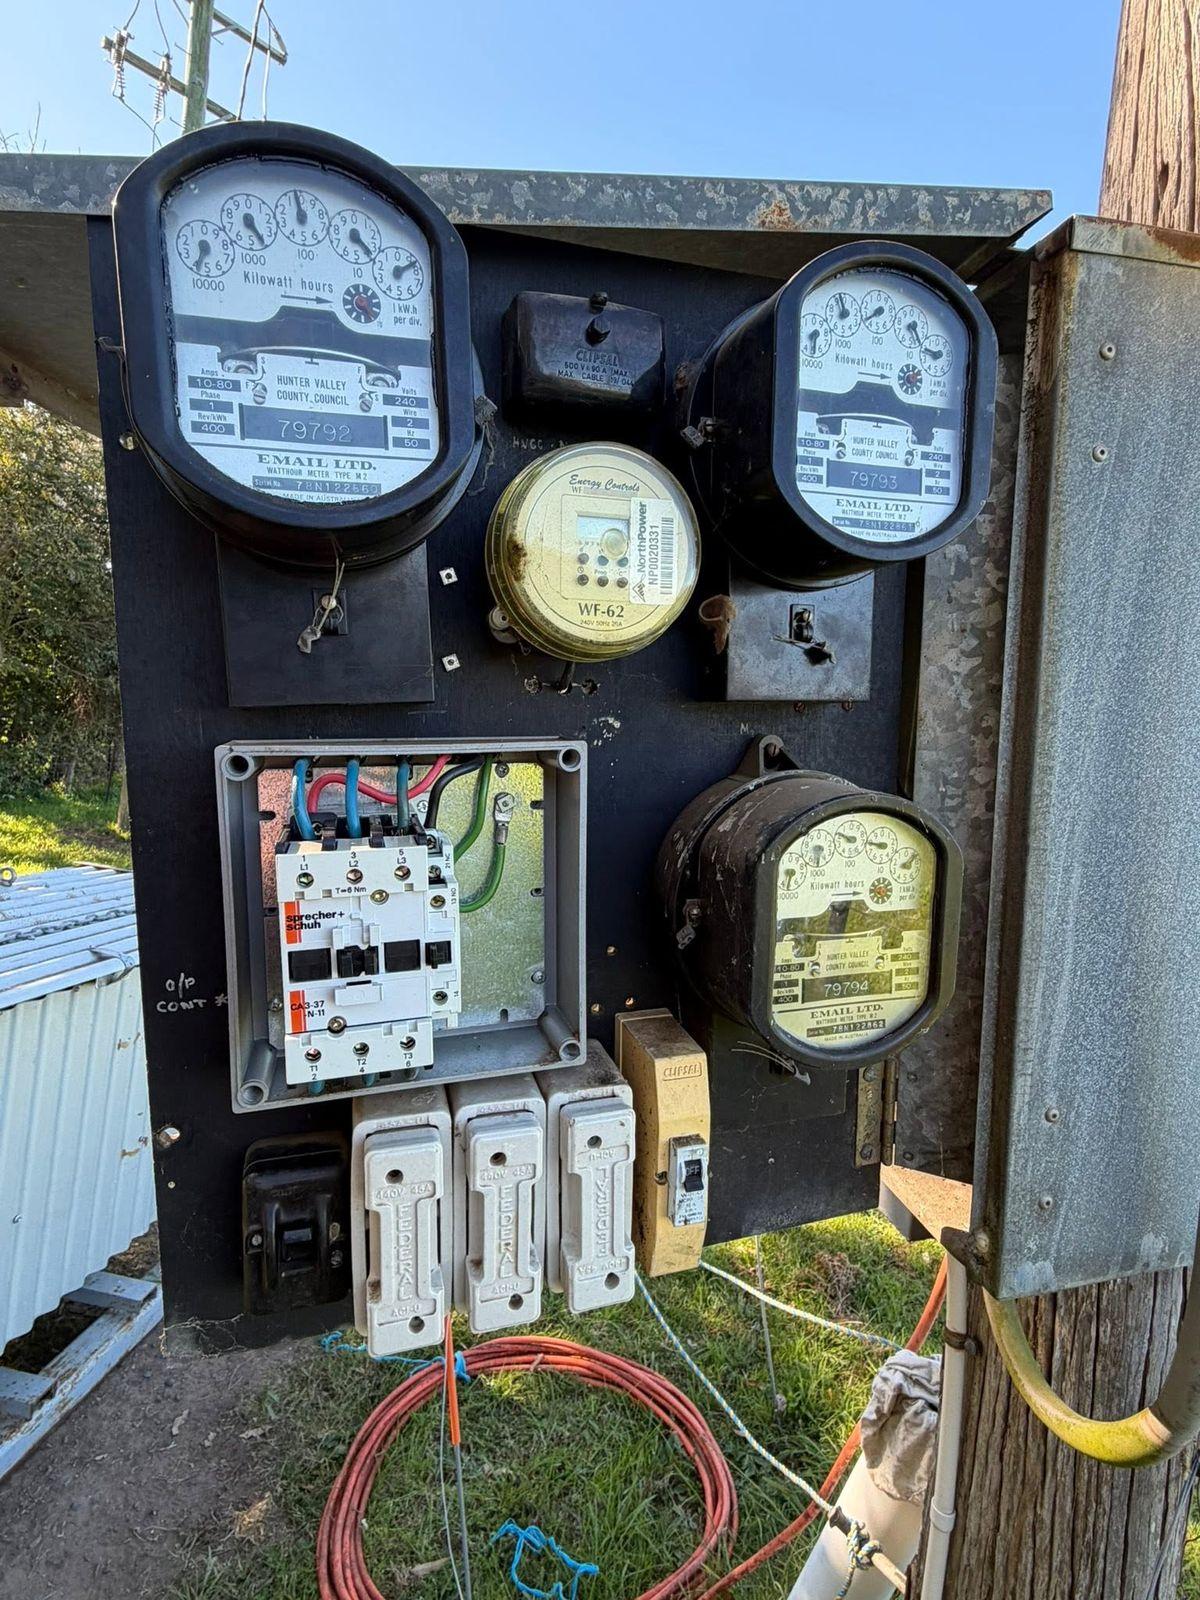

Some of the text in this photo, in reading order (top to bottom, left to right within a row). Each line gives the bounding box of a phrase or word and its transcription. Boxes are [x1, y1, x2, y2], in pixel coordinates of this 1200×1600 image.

[241, 253, 266, 265] 1000
[298, 249, 315, 261] 100
[353, 267, 363, 278] 10
[192, 277, 225, 291] 10000
[244, 271, 334, 294] Kilowatt hours
[394, 316, 406, 326] per
[835, 339, 850, 349] 1000
[872, 336, 883, 345] 100
[576, 349, 618, 367] CLIPSAL
[835, 353, 893, 370] Kilowatt hours
[907, 351, 913, 360] 10
[564, 361, 578, 370] 500
[802, 360, 823, 370] 10000
[201, 368, 218, 376] Amps
[582, 373, 604, 382] CABLE
[197, 379, 232, 389] 10-80
[277, 375, 347, 391] HUNTER VALLEY
[201, 390, 221, 399] Phase
[277, 390, 350, 406] COUNTY COUNCIL
[395, 397, 416, 406] 240
[403, 409, 417, 417] Wire
[202, 424, 225, 433] 400
[407, 419, 413, 427] 2
[278, 420, 352, 442] 79792
[404, 439, 418, 447] 50
[852, 436, 898, 449] HUNTER VALLEY
[852, 448, 899, 460] COUNTY COUNCIL
[928, 453, 943, 461] 240
[257, 454, 377, 471] EMAIL LTD.
[267, 467, 302, 476] WATTHOUR
[308, 470, 330, 478] METER
[335, 471, 351, 479] TYPE
[569, 474, 640, 492] Energy Controls
[850, 470, 898, 490] 79793
[836, 499, 913, 512] EMAIL LTD.
[636, 502, 647, 573] NorthPower
[648, 524, 660, 586] NP0020331
[578, 603, 624, 618] WF-62
[300, 863, 309, 871] L1
[349, 860, 359, 868] L2
[845, 860, 855, 868] 100
[809, 869, 825, 877] 1000
[810, 880, 865, 891] Kilowatt hours
[779, 892, 799, 900] 10000
[285, 910, 346, 925] sprecher+
[286, 920, 321, 932] schuh
[824, 980, 869, 998] 79794
[156, 999, 207, 1013] CONT
[810, 1004, 884, 1019] EMAIL LTD.
[405, 1060, 411, 1068] 6
[664, 1064, 700, 1077] CLIPSAL
[499, 1184, 513, 1279] FEDERAL
[397, 1203, 412, 1301] FEDERAL
